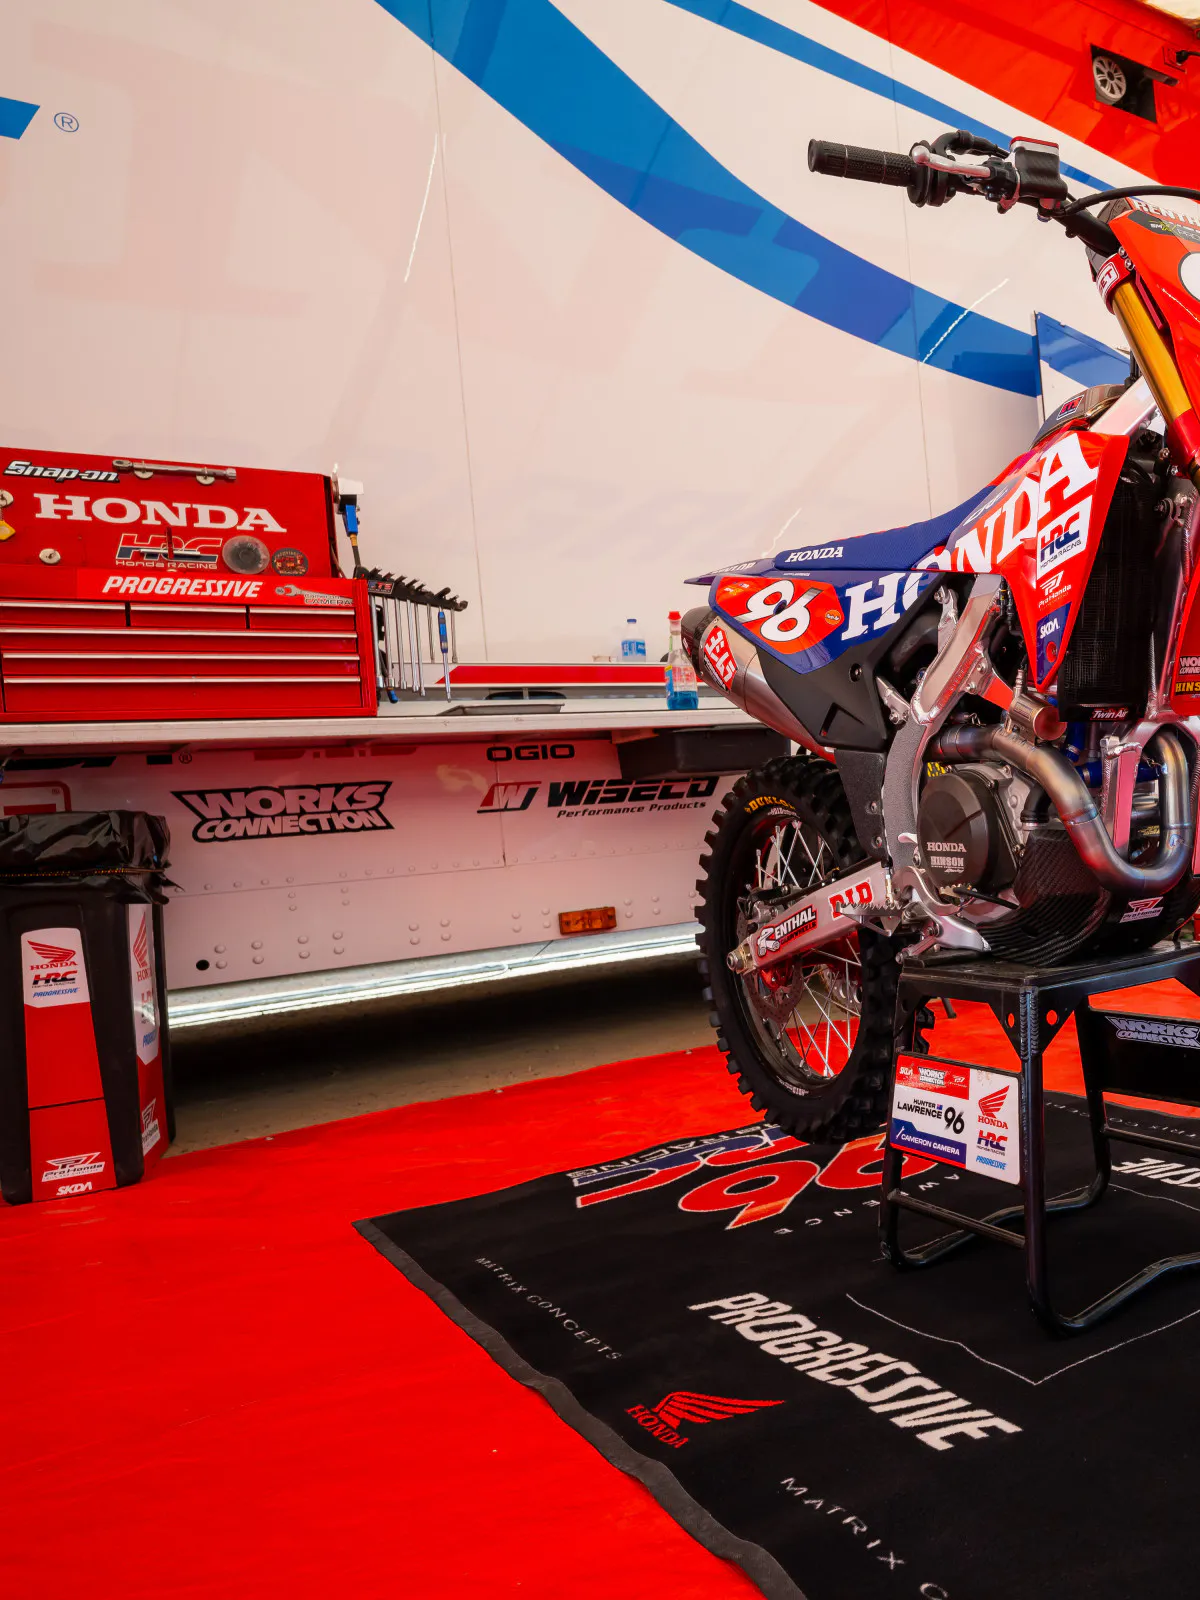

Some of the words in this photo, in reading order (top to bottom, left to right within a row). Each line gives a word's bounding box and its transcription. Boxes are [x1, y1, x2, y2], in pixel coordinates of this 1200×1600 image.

[4, 460, 119, 483] Snap-on
[34, 493, 287, 533] HONDA
[841, 432, 1099, 641] HONDA
[1040, 511, 1080, 562] HRC
[115, 560, 164, 568] Honda
[167, 560, 217, 570] RACING
[785, 546, 844, 563] HONDA
[101, 576, 263, 598] PROGRESSIVE
[733, 580, 823, 642] 96
[486, 743, 575, 762] OGIO
[184, 782, 388, 818] WORKS
[556, 806, 644, 818] Performance
[649, 800, 706, 813] Products
[193, 808, 388, 840] CONNECTION
[926, 841, 967, 852] HONDA
[930, 856, 964, 867] HINSON
[29, 961, 78, 971] HONDA
[32, 970, 78, 986] HRC
[32, 987, 79, 998] PROGRESSIVE
[913, 1099, 936, 1109] HUNTER
[897, 1102, 943, 1119] LAWRENCE
[944, 1106, 965, 1134] 96
[977, 1116, 1008, 1130] HONDA
[901, 1133, 932, 1148] CAMERON
[932, 1142, 960, 1156] CAMERA
[977, 1130, 1007, 1152] HRC
[976, 1155, 1008, 1170] PROGRESSIVE
[56, 1181, 93, 1196] SKDA
[474, 1257, 528, 1294] MATRIX
[525, 1294, 623, 1361] CONCEPTS
[687, 1292, 1023, 1451] PROGRESSIVE
[624, 1404, 690, 1449] HONDA
[780, 1476, 905, 1571] MATRIX
